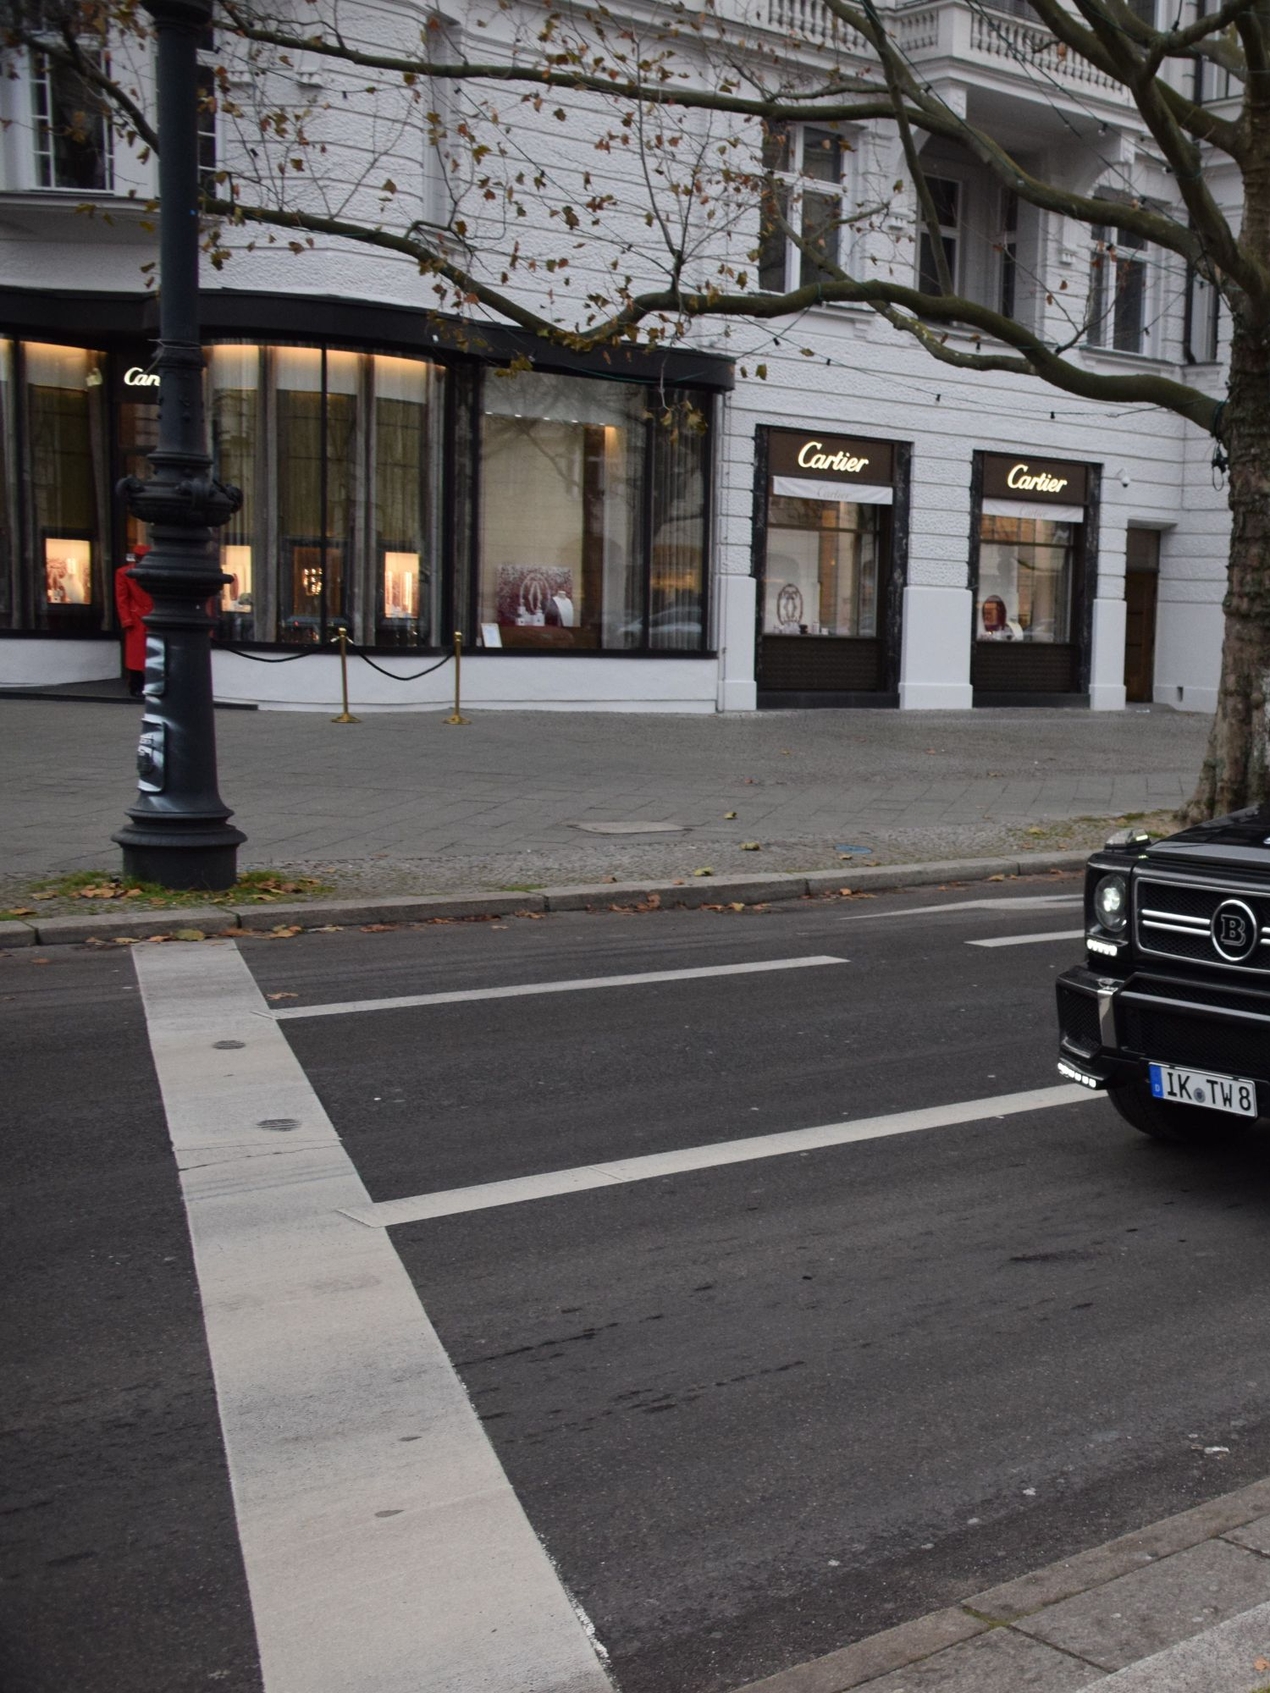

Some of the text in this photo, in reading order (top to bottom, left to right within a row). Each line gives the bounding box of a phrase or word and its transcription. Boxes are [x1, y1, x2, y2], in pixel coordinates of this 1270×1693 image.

[798, 441, 869, 472] Cartier
[1007, 464, 1068, 492] Cartier
[1221, 914, 1246, 946] B
[1167, 1072, 1192, 1100] IK
[1206, 1079, 1233, 1108] TW
[1239, 1086, 1251, 1111] 8
